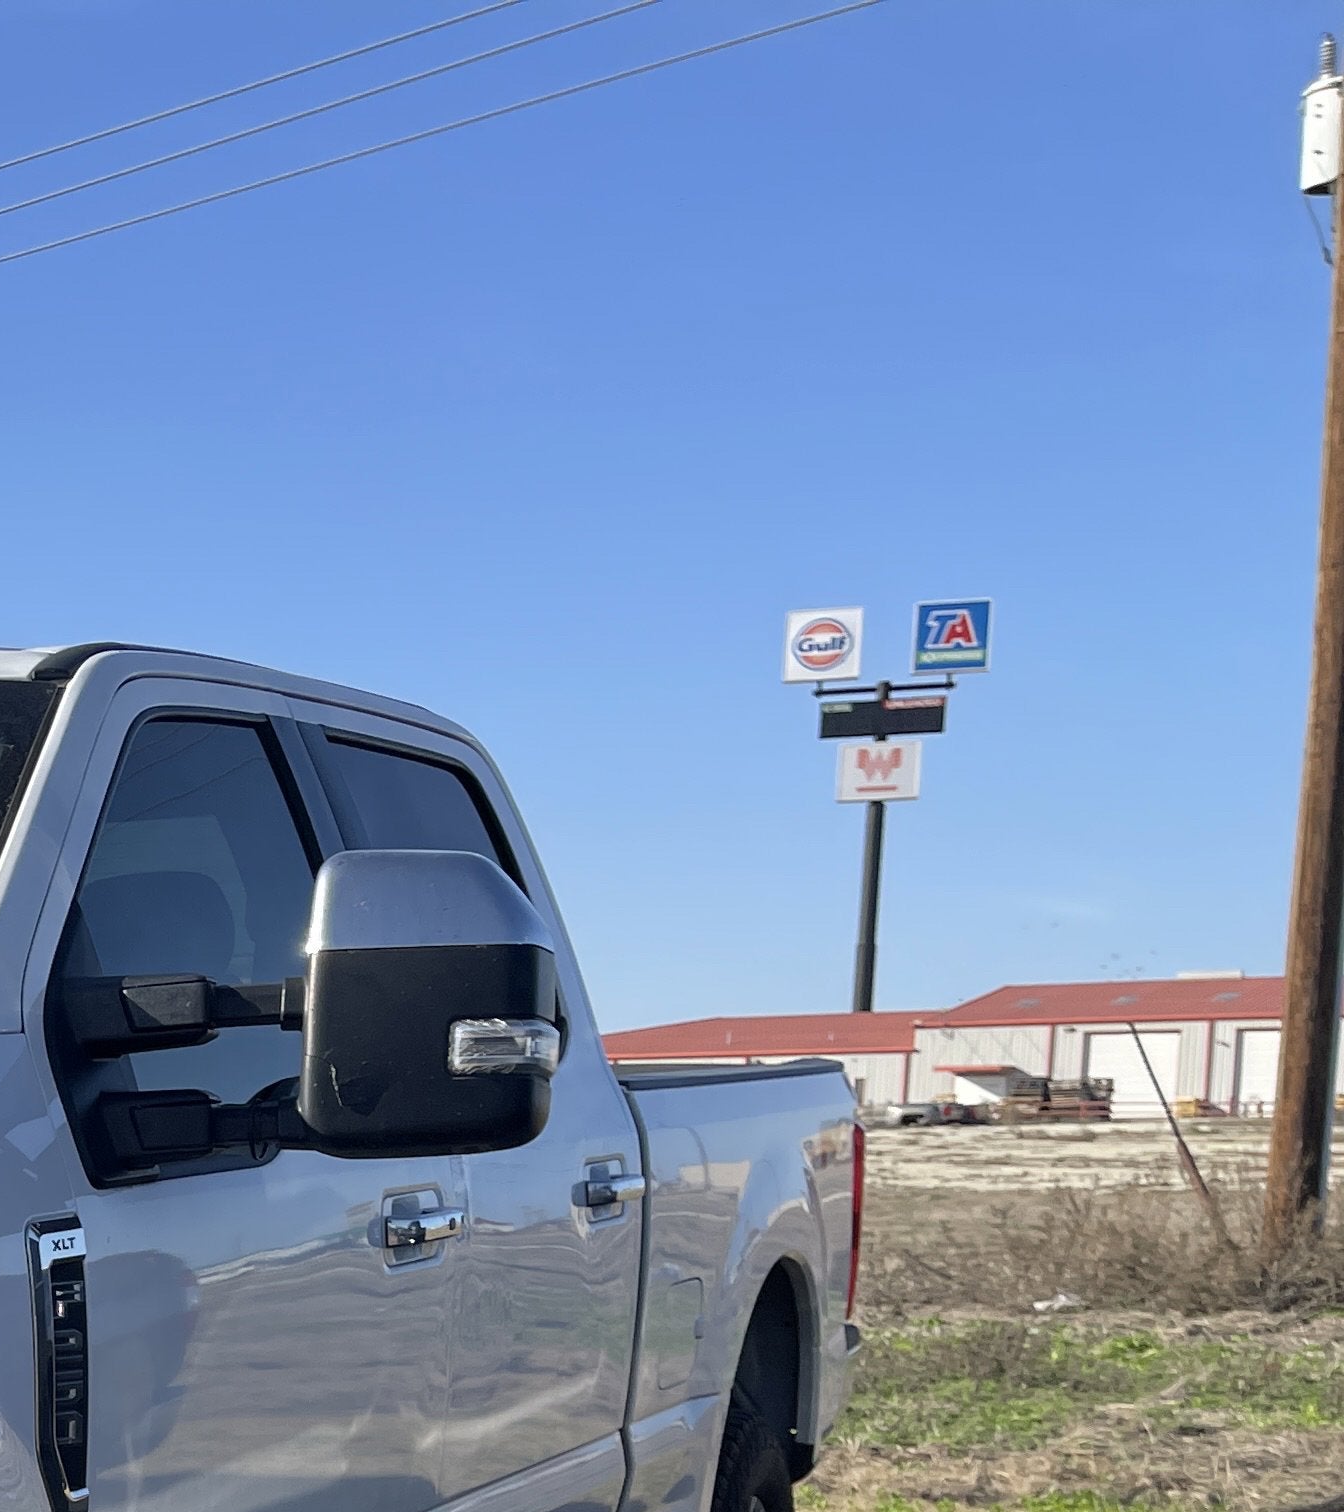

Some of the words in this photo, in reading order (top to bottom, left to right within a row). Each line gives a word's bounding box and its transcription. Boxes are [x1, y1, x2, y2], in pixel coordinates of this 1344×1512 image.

[924, 609, 979, 649] TA
[798, 636, 847, 653] Gulf
[51, 1236, 76, 1251] XLT
